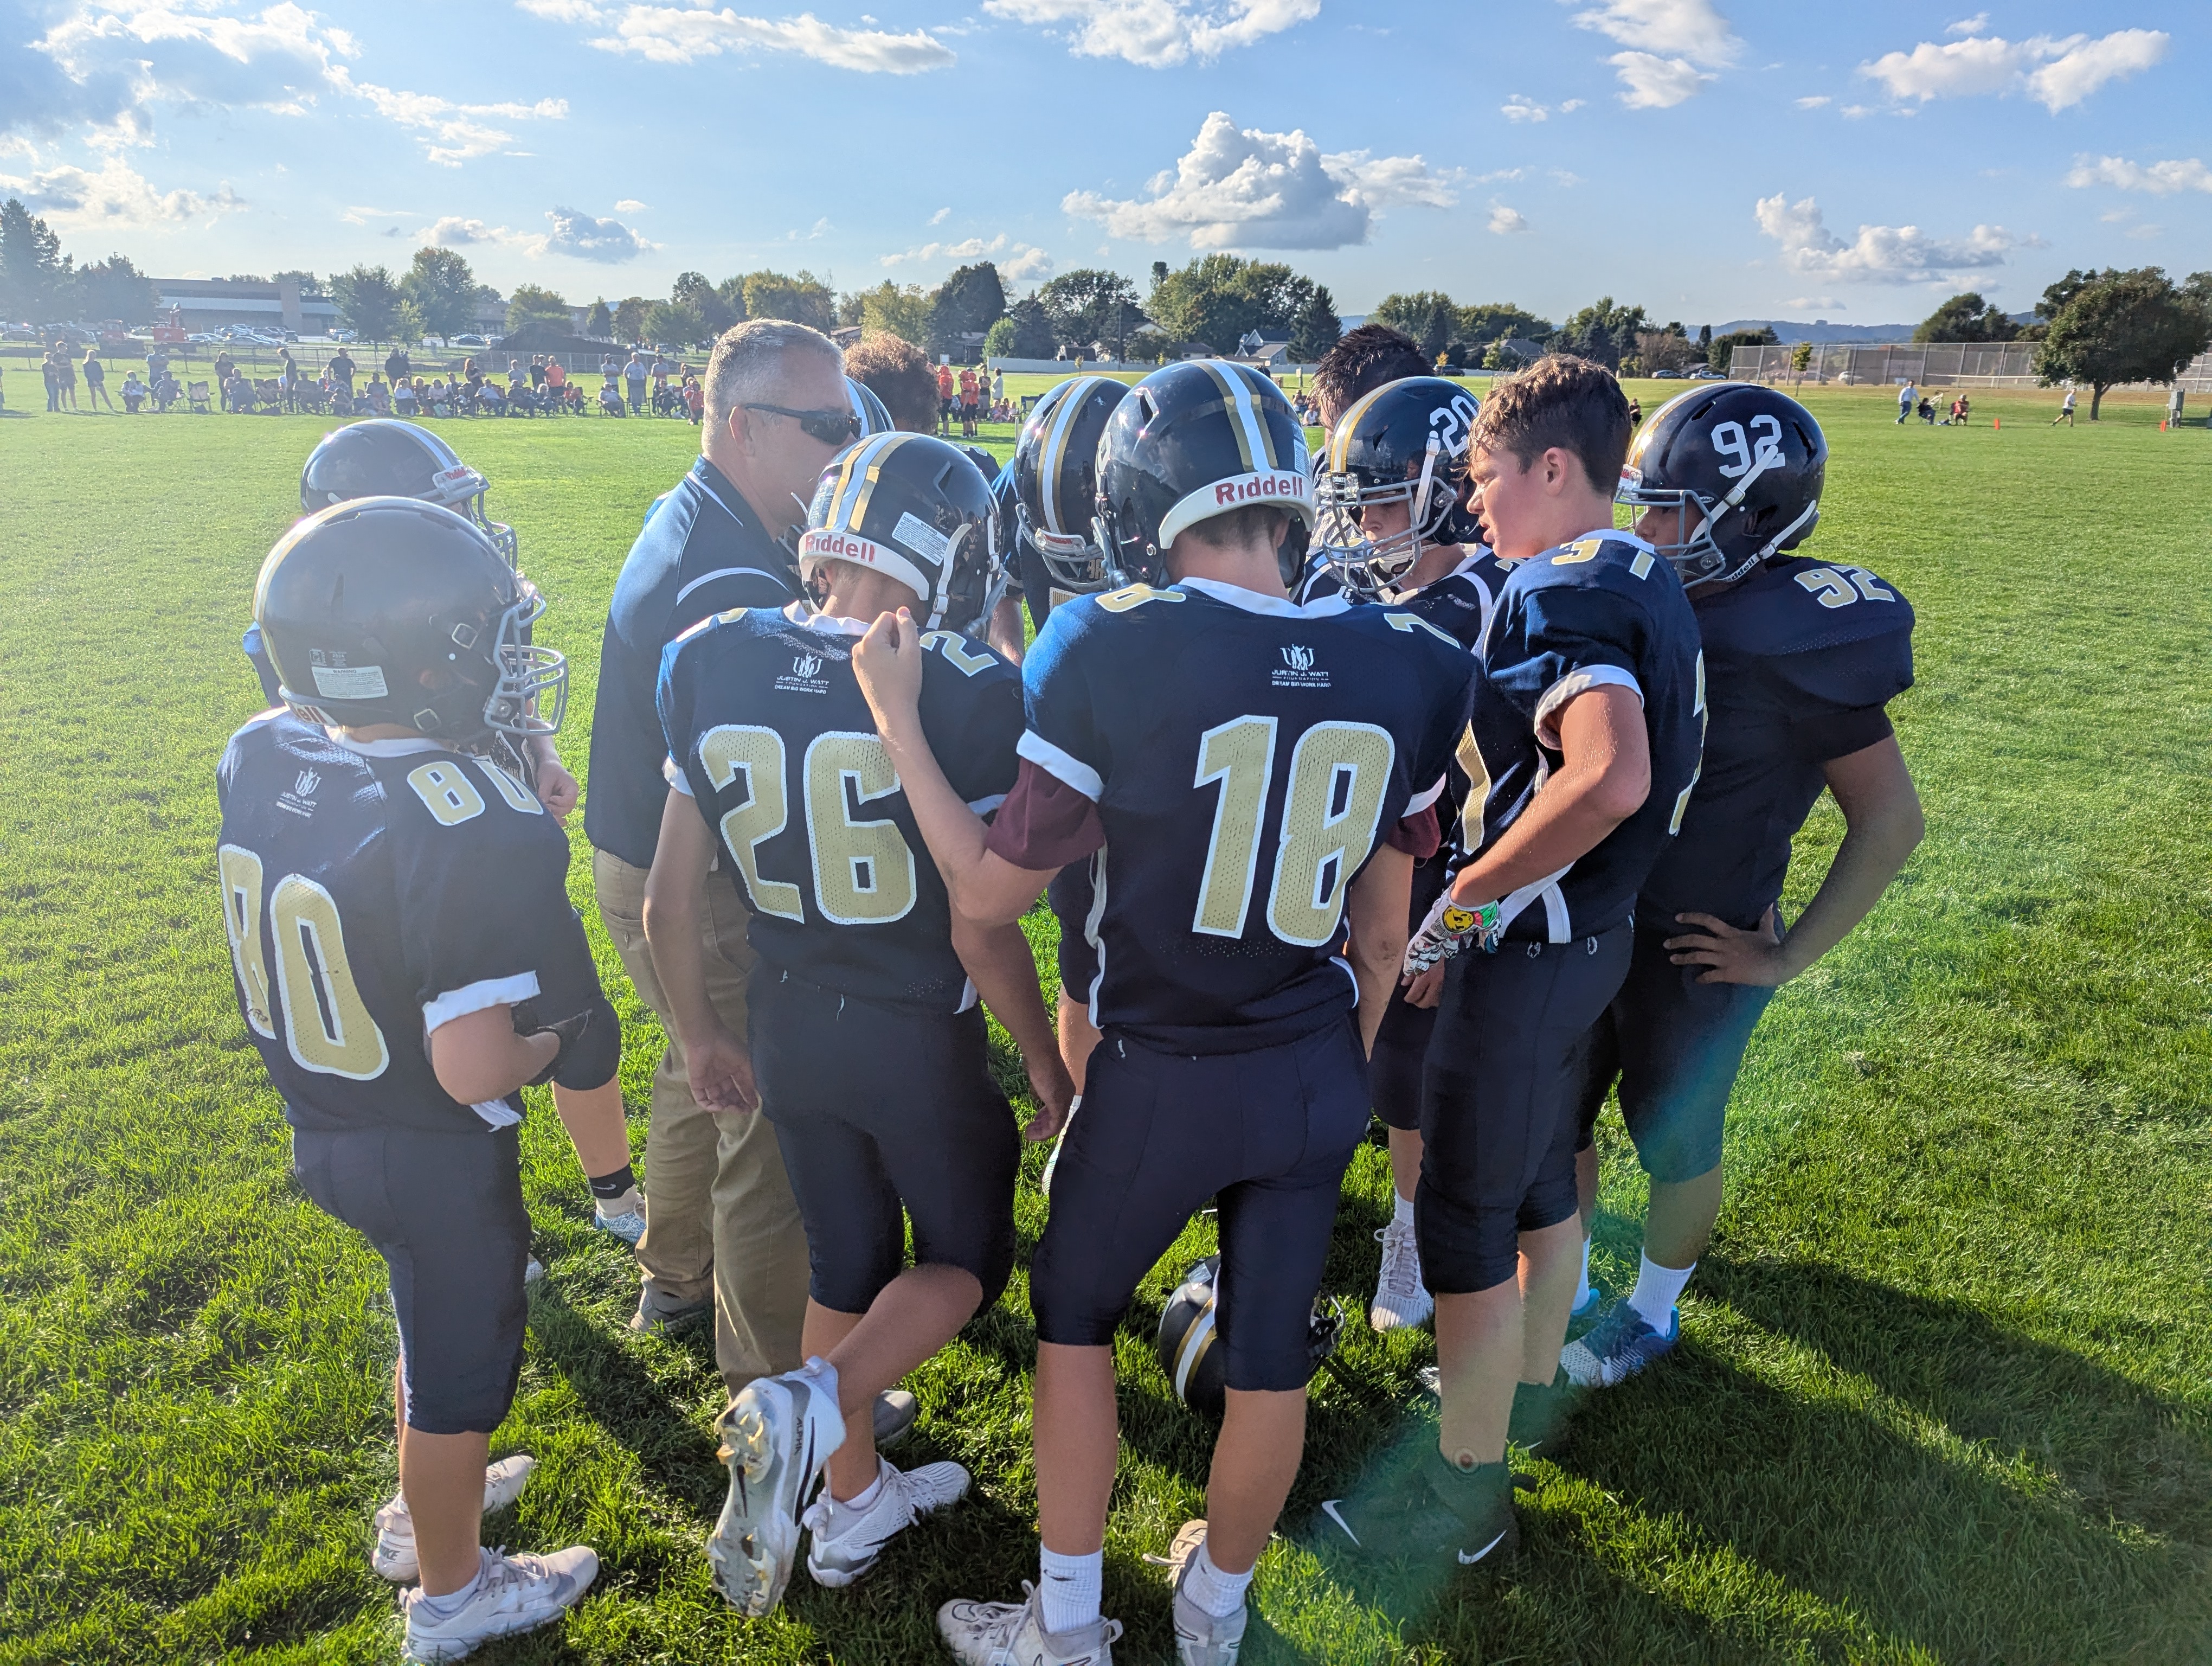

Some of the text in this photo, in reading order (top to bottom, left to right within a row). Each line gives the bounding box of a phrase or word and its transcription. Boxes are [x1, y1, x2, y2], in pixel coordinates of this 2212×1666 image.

[1430, 395, 1478, 458] 20
[1711, 414, 1785, 478] 92
[1216, 475, 1303, 505] Riddell
[805, 534, 875, 563] Riddell
[1795, 565, 1895, 608] 92
[407, 759, 544, 826] 80
[699, 725, 917, 925] 26
[1192, 715, 1395, 947] 18
[219, 844, 389, 1081] 80
